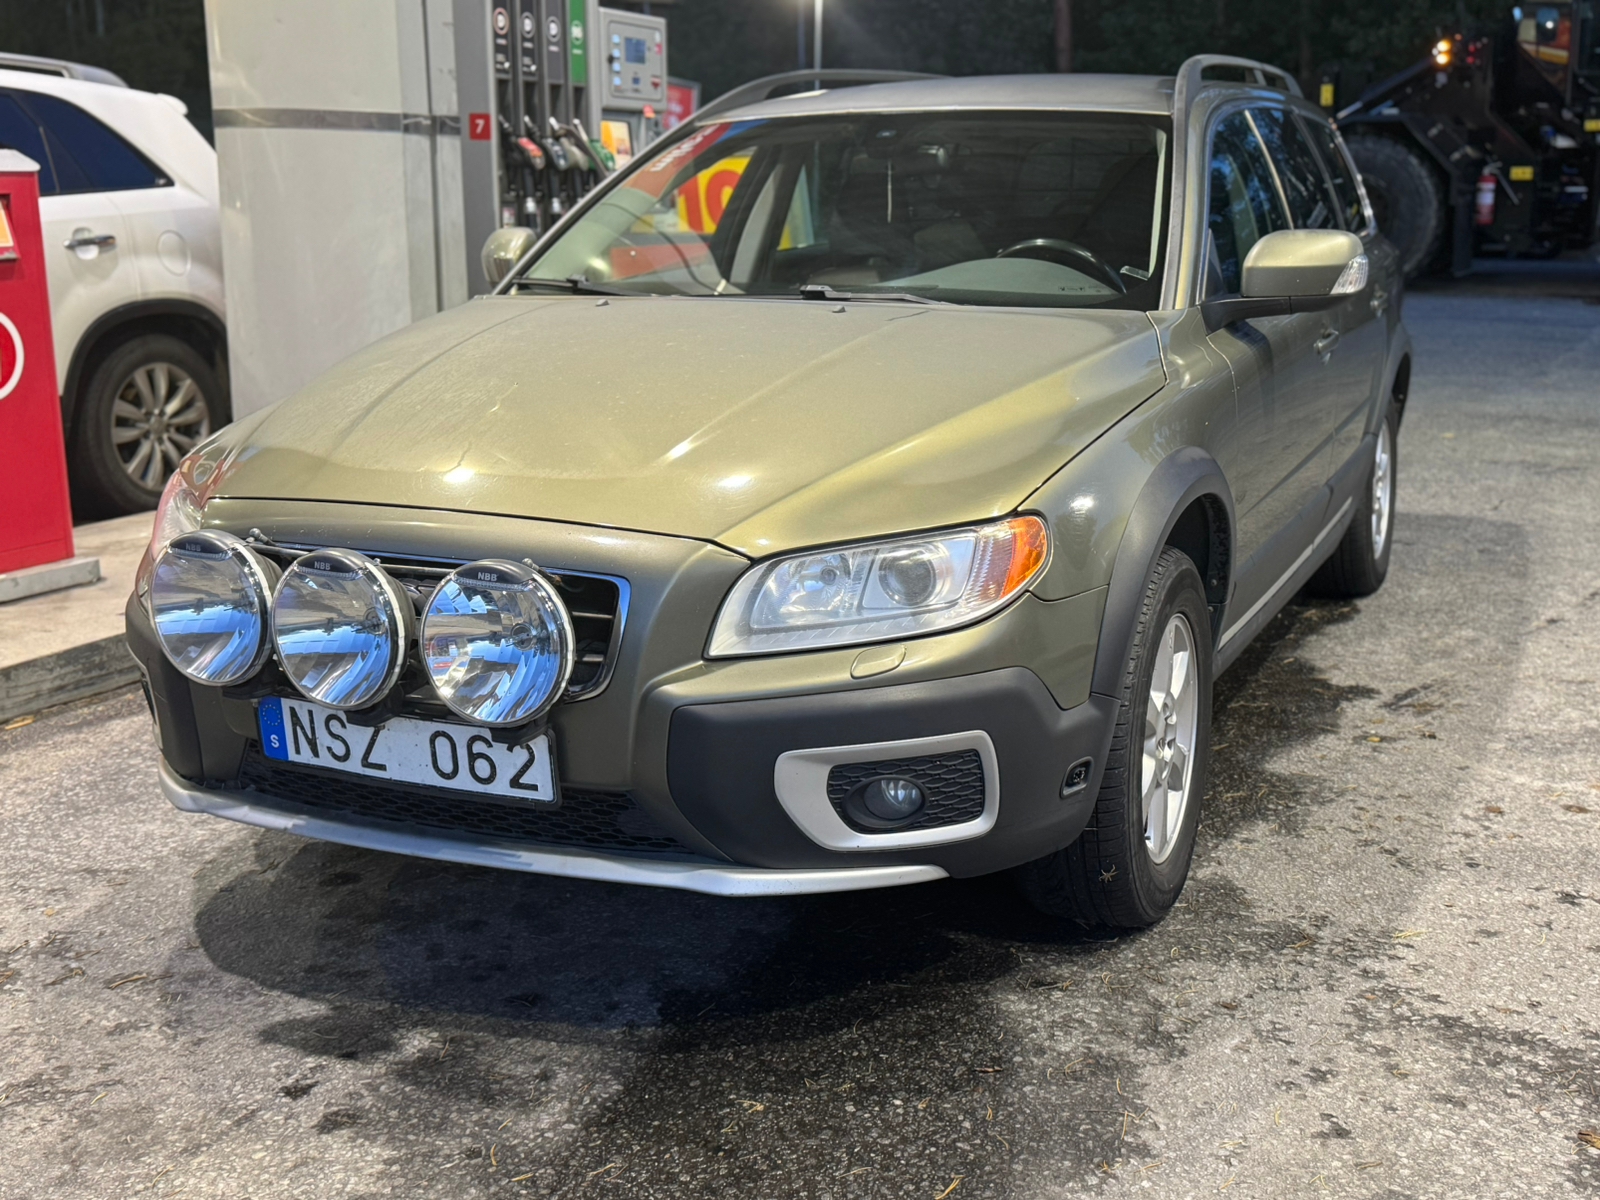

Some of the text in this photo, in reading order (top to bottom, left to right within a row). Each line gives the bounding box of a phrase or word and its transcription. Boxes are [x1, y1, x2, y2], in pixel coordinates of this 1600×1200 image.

[474, 119, 485, 134] 7
[185, 542, 202, 552] NBB
[314, 560, 331, 570] NBB
[477, 571, 498, 582] NBB
[270, 734, 280, 748] S
[289, 706, 539, 792] NSZ 062
